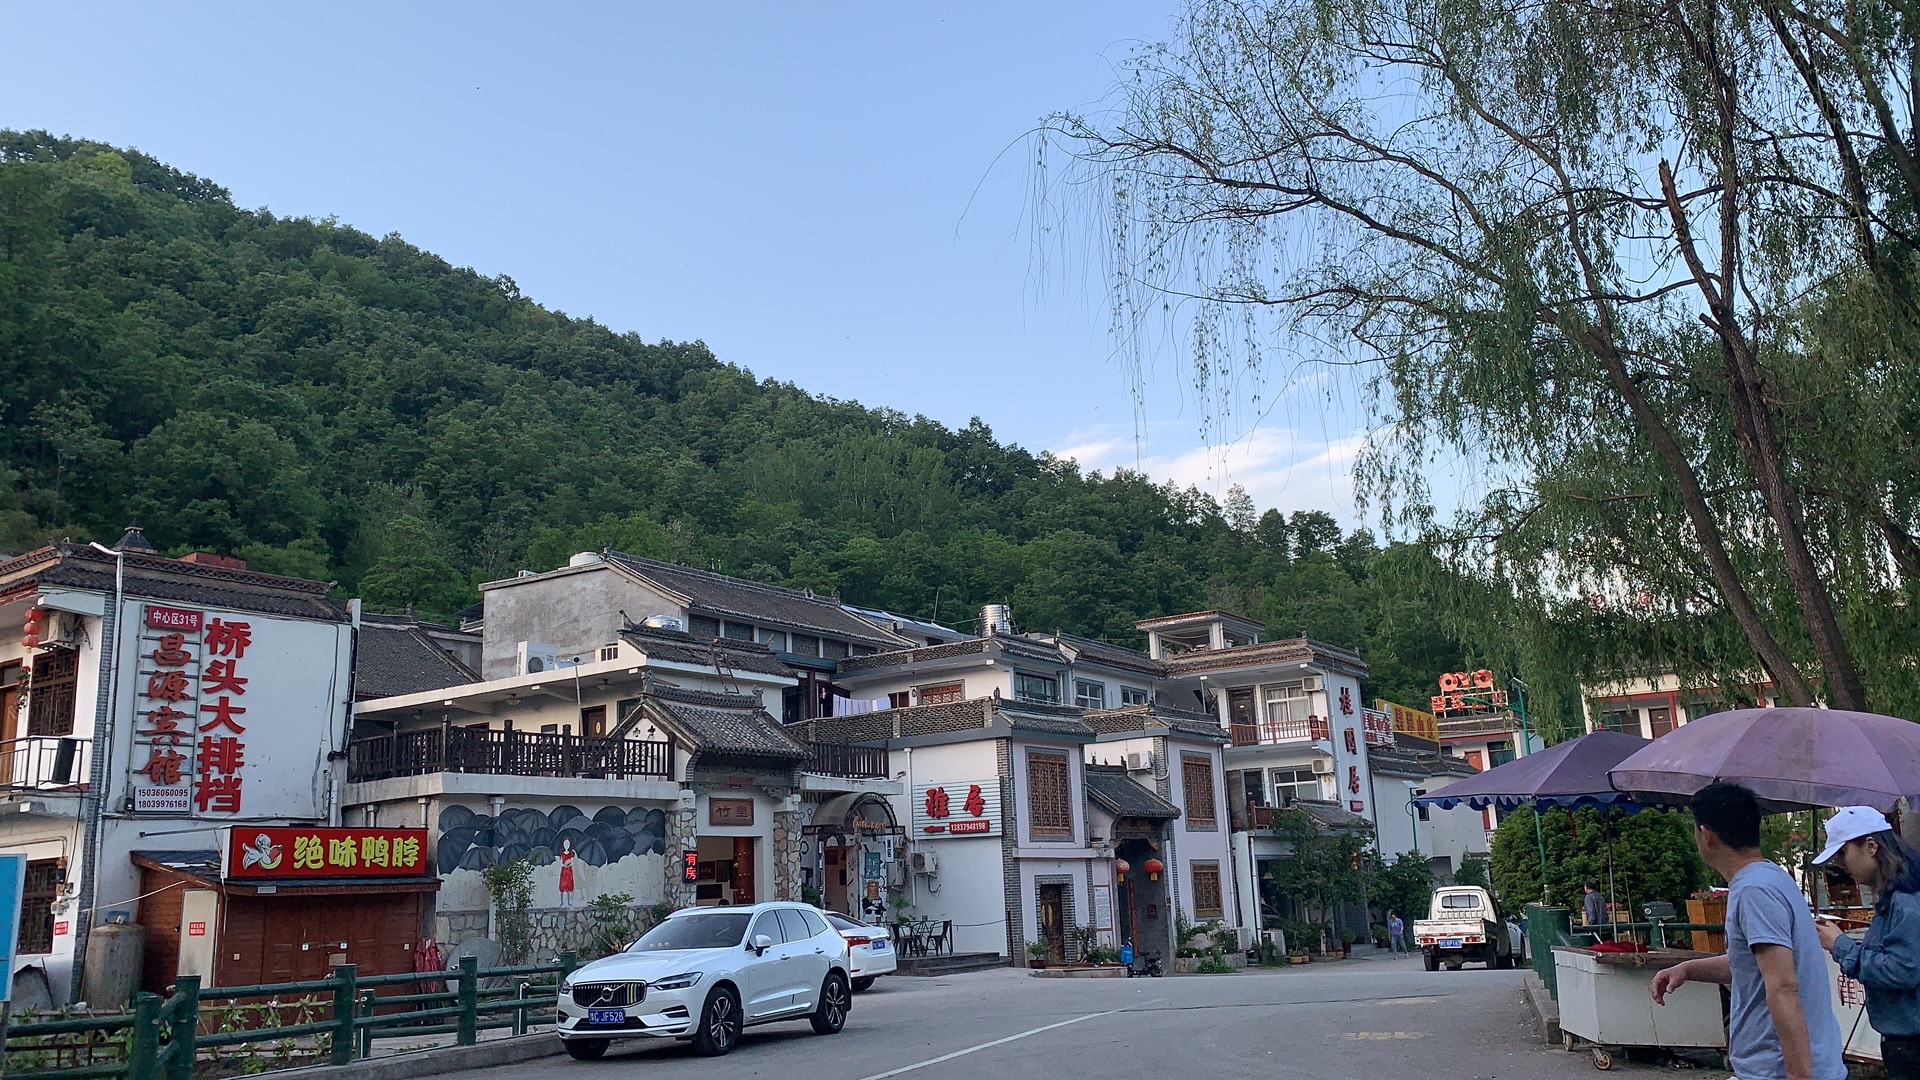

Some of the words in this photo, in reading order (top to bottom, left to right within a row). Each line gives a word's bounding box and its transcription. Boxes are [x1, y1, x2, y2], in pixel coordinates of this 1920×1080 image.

[153, 610, 198, 627] 中心区31号
[139, 632, 192, 785] 昌源宾馆
[193, 617, 252, 814] 桥头大排档
[138, 788, 189, 797] 15036060095
[138, 800, 188, 808] 18039976168
[925, 784, 986, 819] 雅居
[293, 834, 420, 869] 绝味鸭脖
[685, 852, 698, 880] 有房
